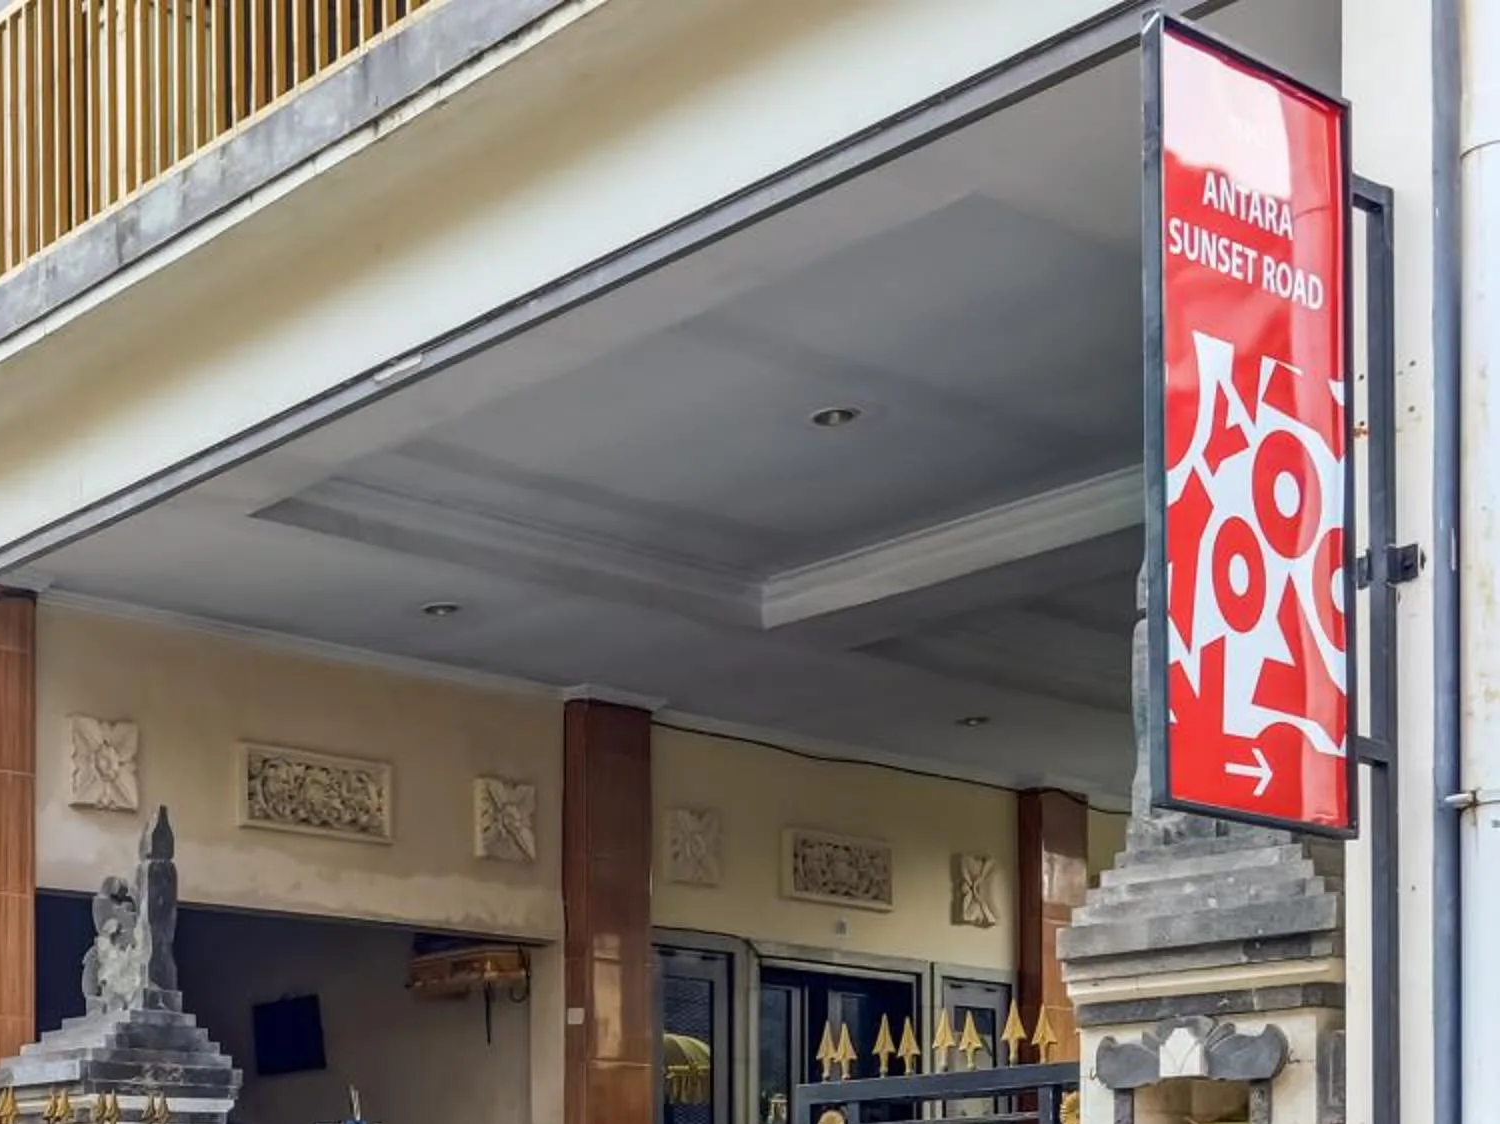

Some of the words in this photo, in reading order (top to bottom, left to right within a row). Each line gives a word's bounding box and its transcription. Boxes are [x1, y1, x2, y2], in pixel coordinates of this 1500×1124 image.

[1202, 171, 1294, 240] ANTARA
[1167, 217, 1258, 284] SUNSET
[1261, 255, 1323, 310] ROAD
